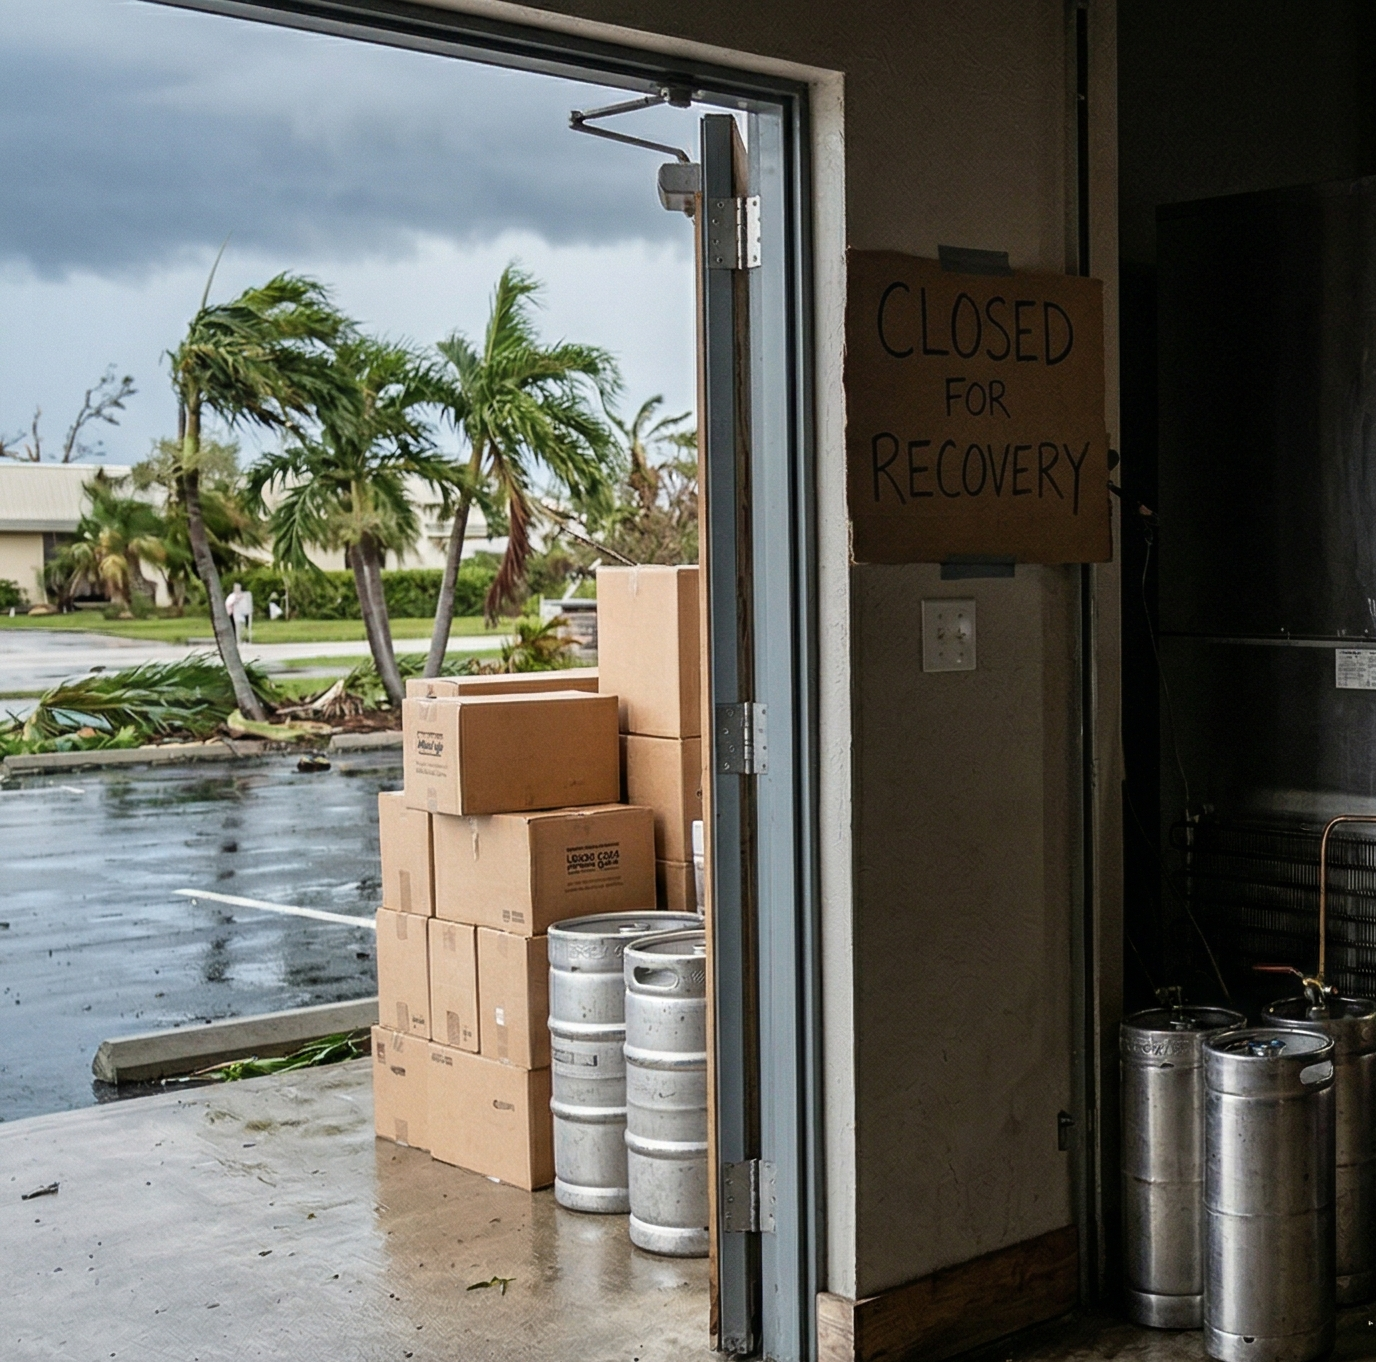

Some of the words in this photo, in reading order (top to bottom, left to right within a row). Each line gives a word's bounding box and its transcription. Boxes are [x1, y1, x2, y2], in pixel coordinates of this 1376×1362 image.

[877, 281, 1074, 366] CLOSED
[945, 376, 1011, 419] FOR
[871, 431, 1090, 516] RECOVERY
